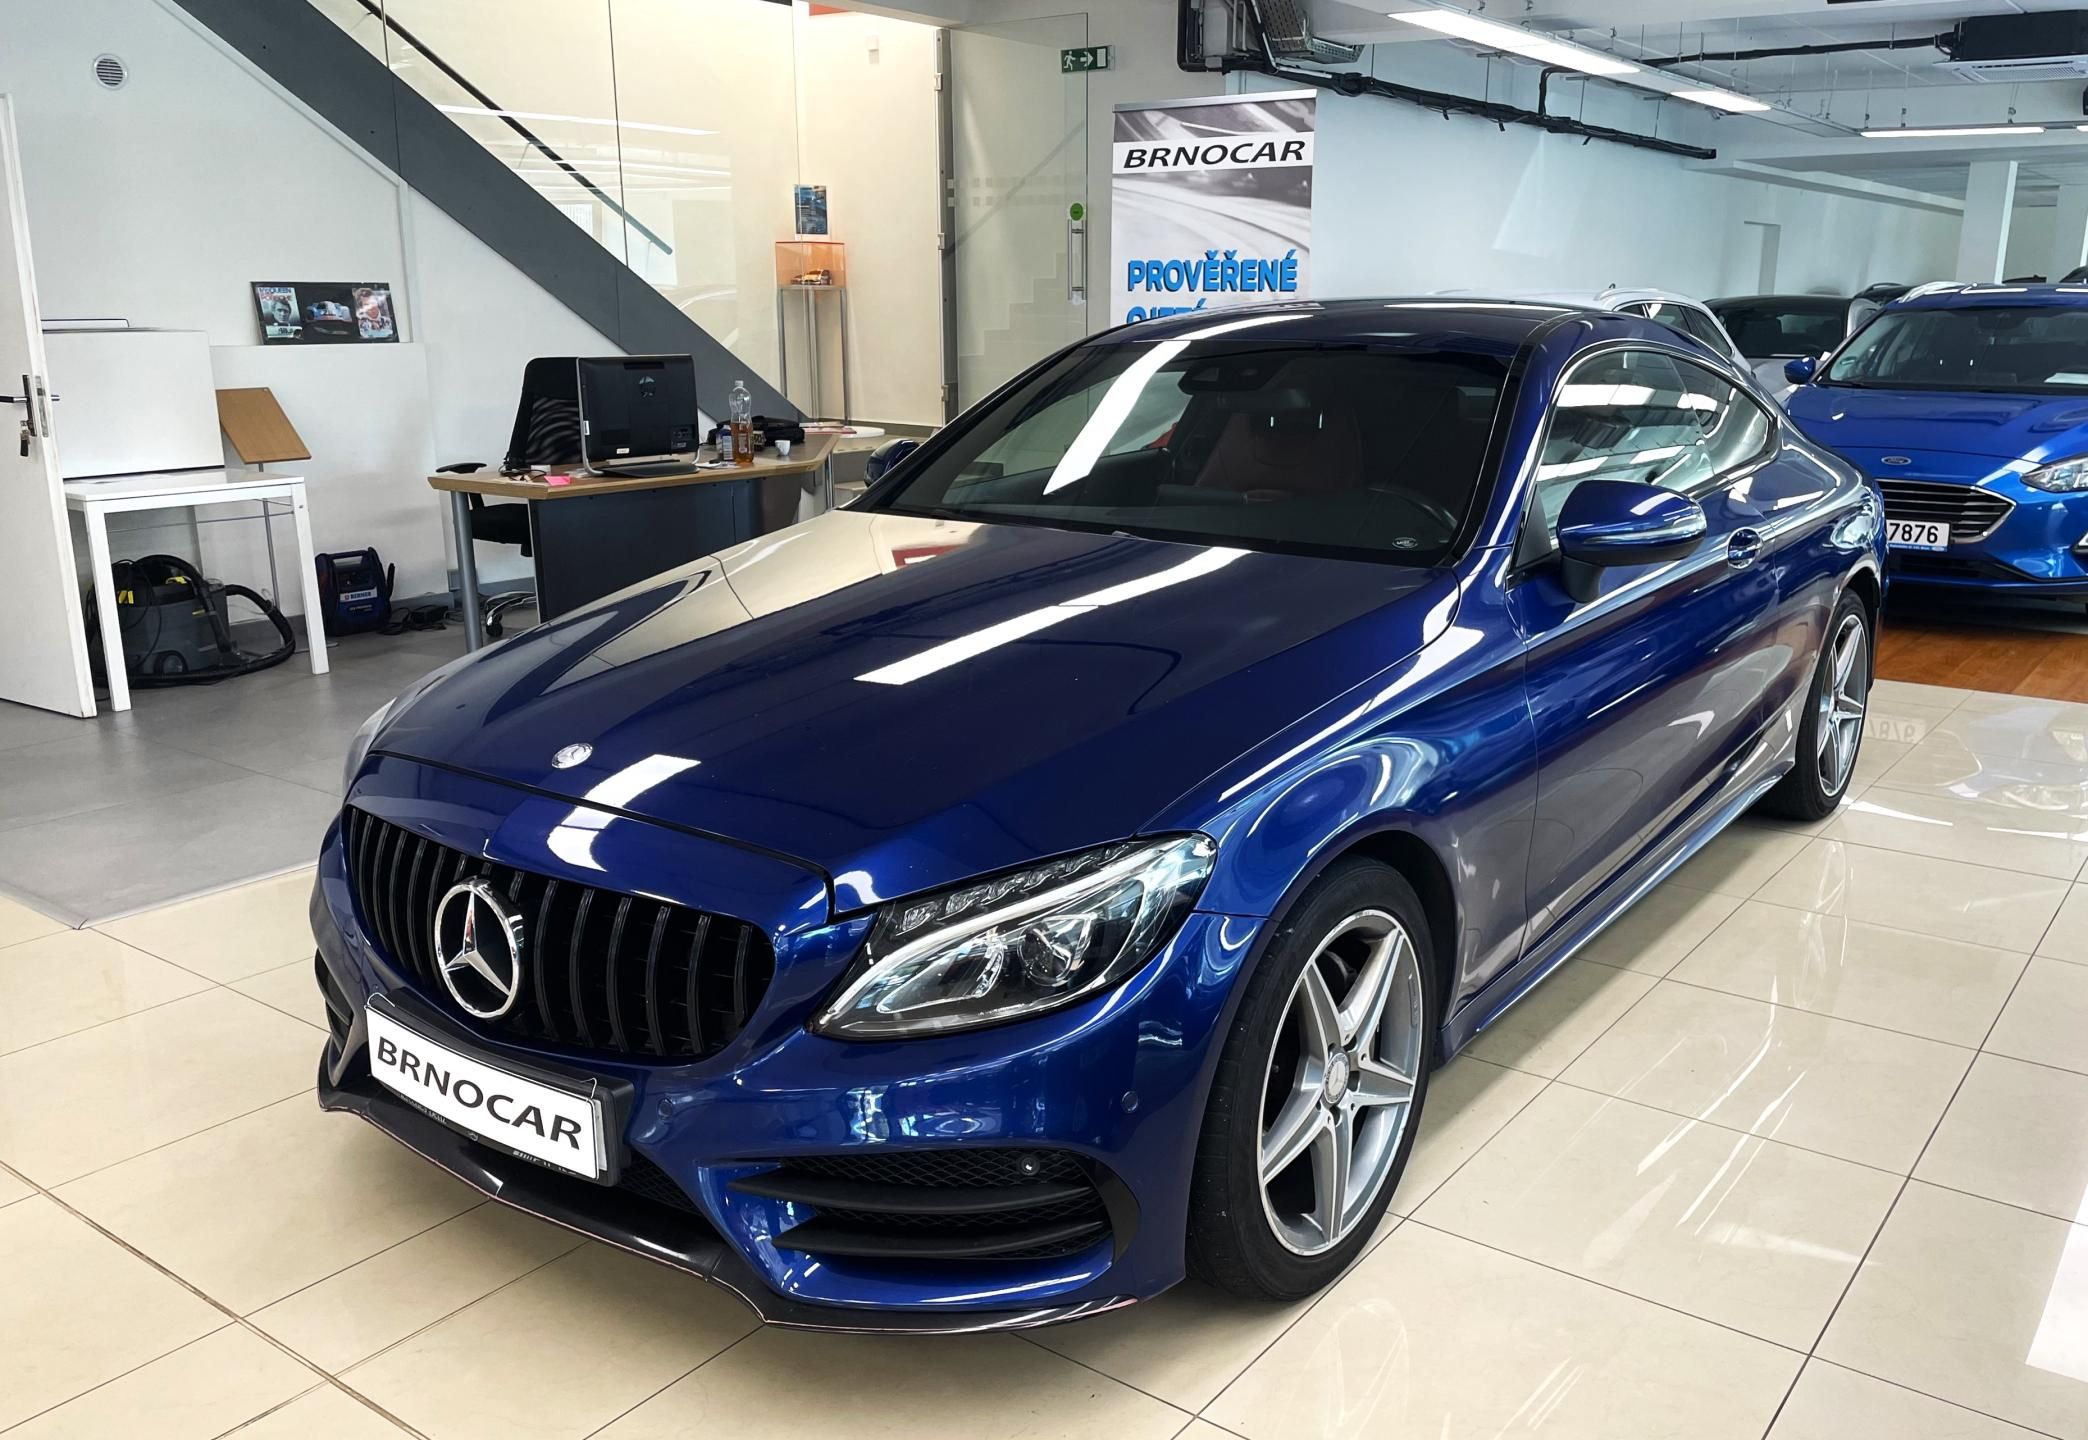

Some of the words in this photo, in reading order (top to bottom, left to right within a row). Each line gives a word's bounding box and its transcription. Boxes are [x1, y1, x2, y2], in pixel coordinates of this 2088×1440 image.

[1123, 140, 1306, 169] BRNOCAR
[1127, 249, 1298, 292] PROVĚŘENÉ
[1889, 522, 1939, 544] 7876
[376, 1036, 582, 1151] BRNOCAR
